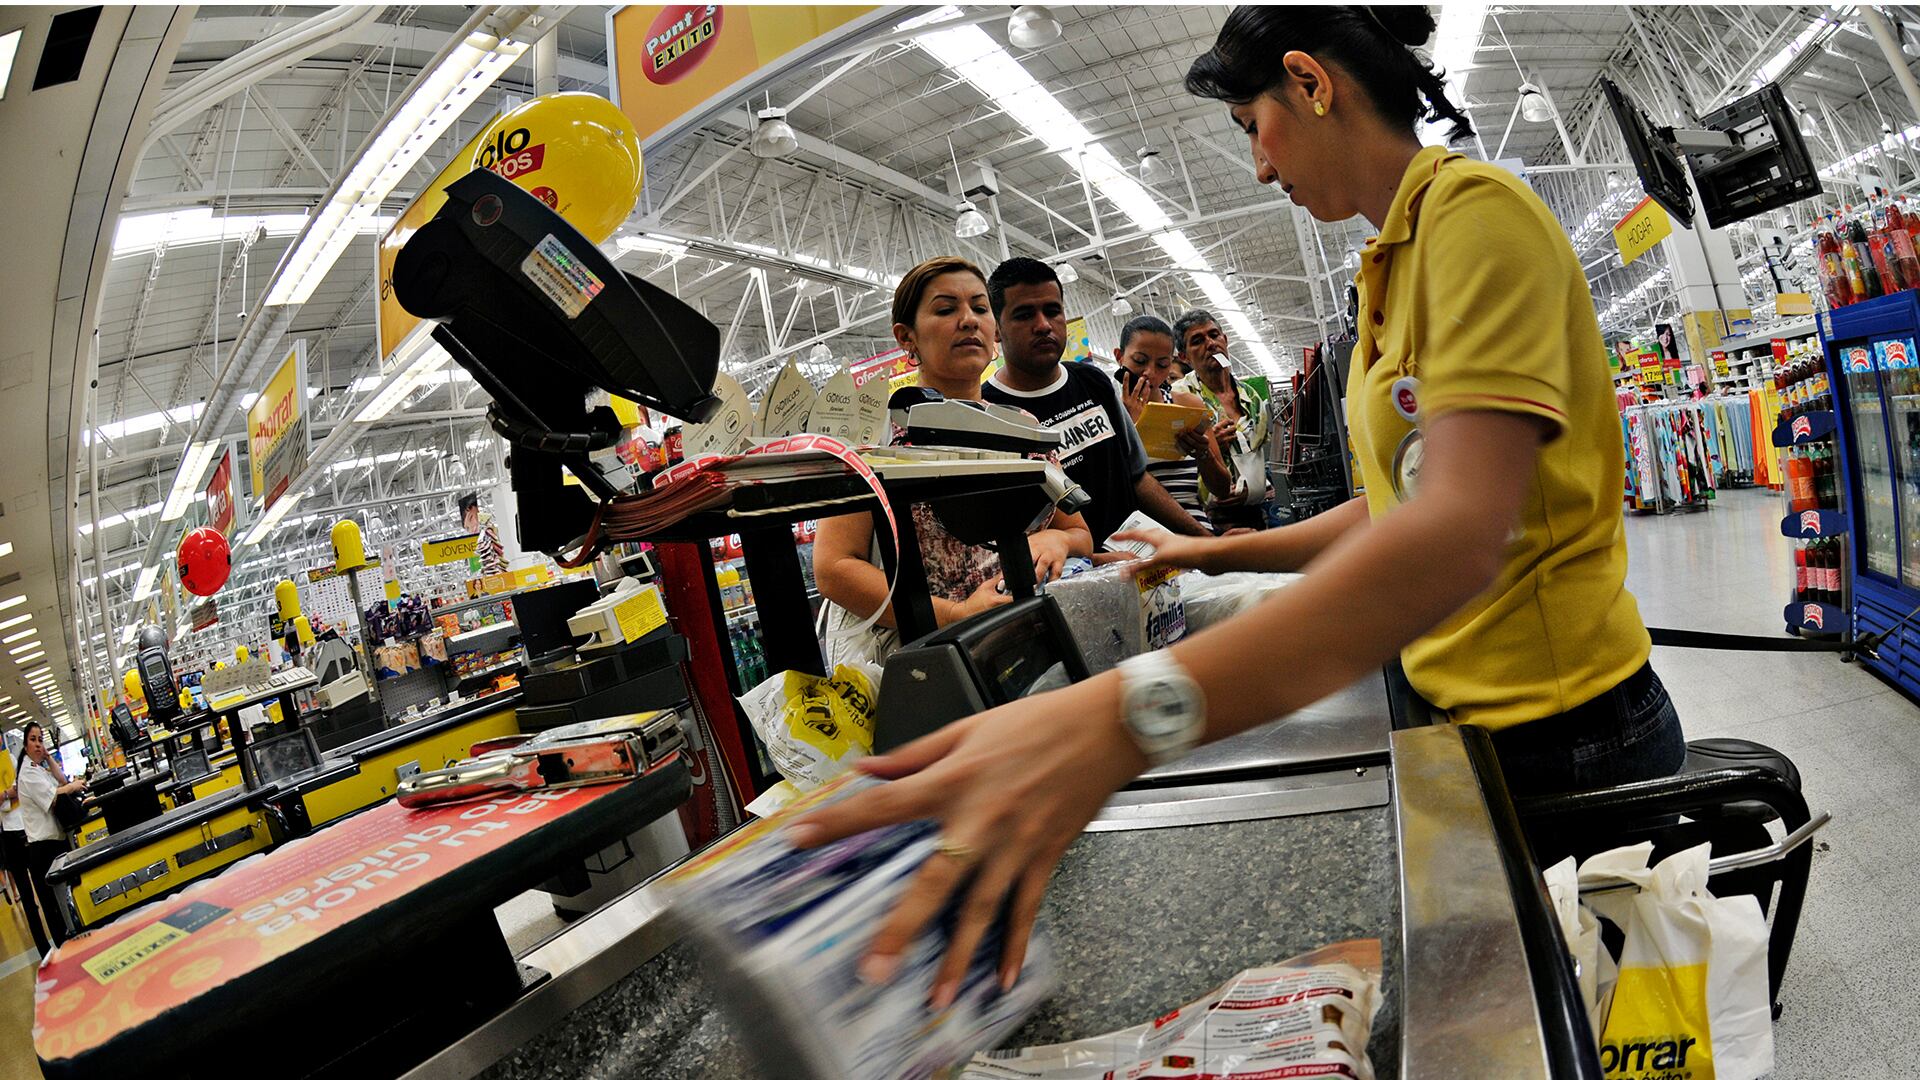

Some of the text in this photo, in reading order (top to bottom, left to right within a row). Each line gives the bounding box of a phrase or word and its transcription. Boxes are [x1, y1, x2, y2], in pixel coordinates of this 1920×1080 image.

[1626, 216, 1655, 249] HOGAR
[1145, 599, 1186, 643] familia
[437, 820, 510, 848] tu
[255, 851, 432, 937] cuota
